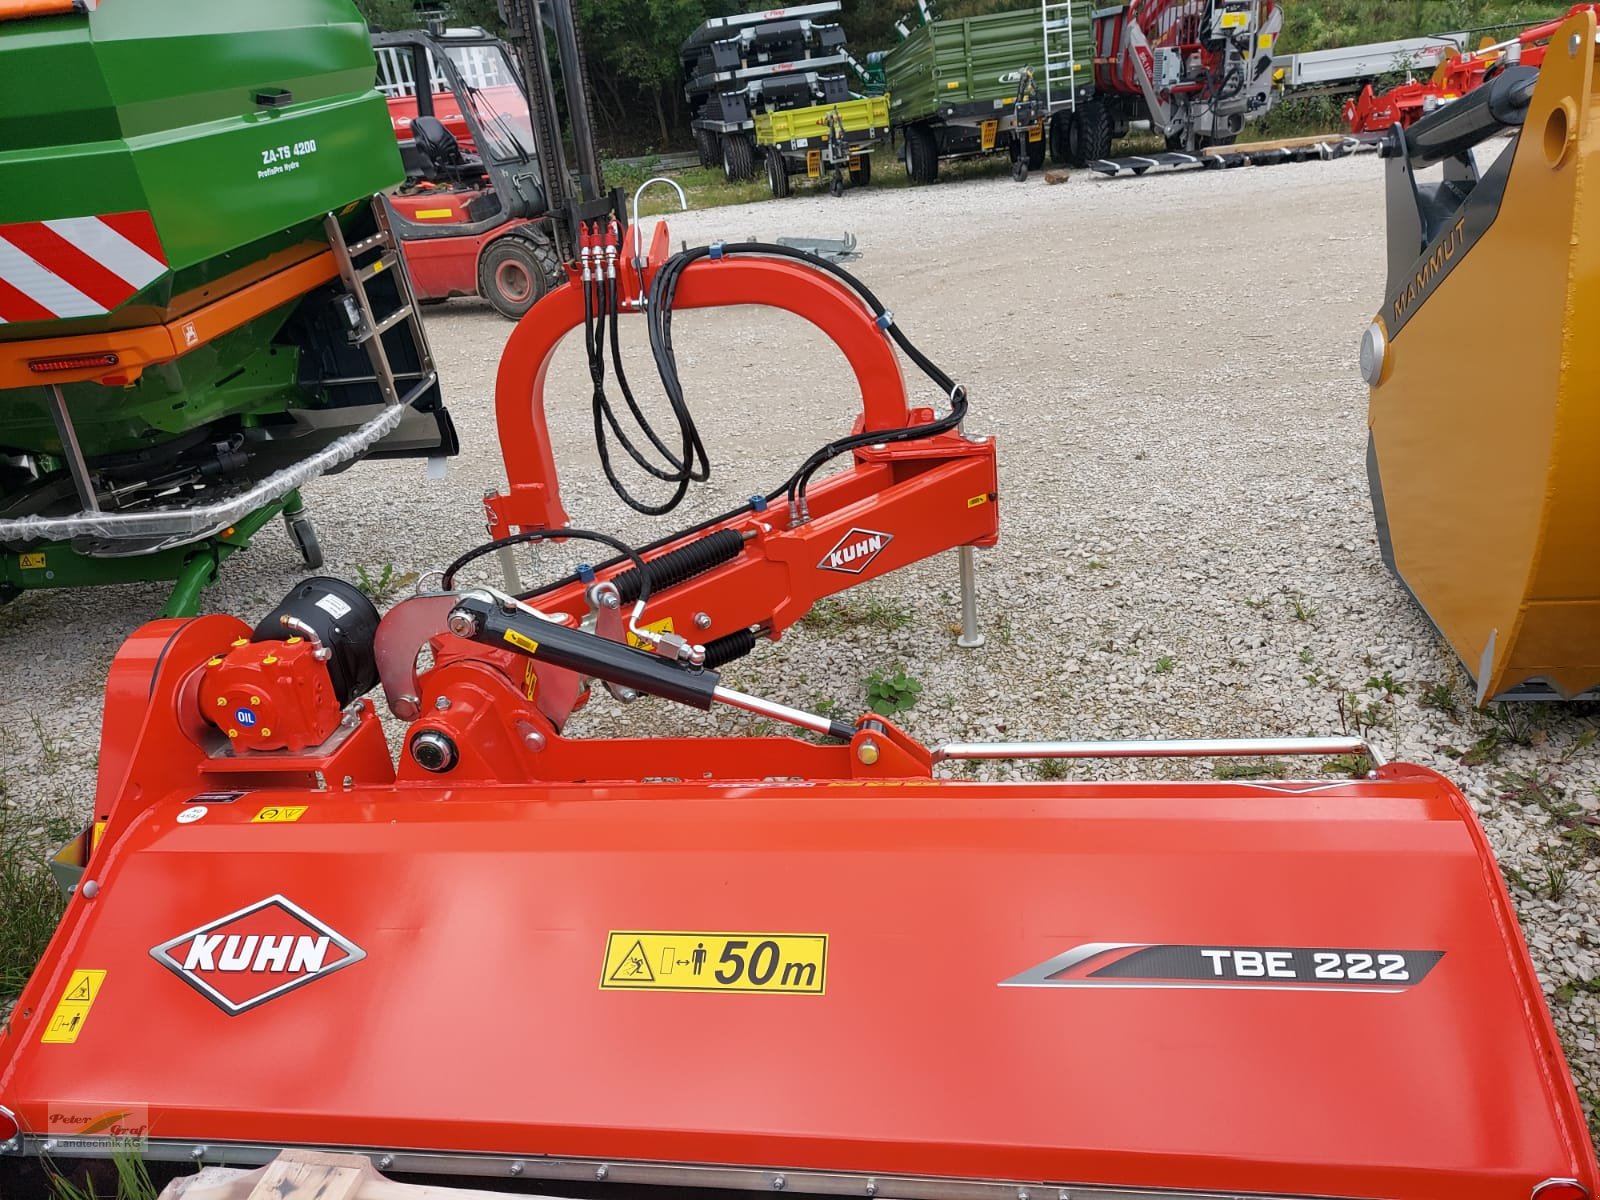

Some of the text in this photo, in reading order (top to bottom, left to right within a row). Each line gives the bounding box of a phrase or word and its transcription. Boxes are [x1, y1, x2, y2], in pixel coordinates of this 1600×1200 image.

[293, 139, 317, 156] 4200
[1393, 216, 1465, 322] MAMMUT
[830, 535, 882, 568] KUHN
[238, 711, 254, 724] OIL
[183, 934, 329, 974] KUHN
[1200, 949, 1410, 980] TBE 222
